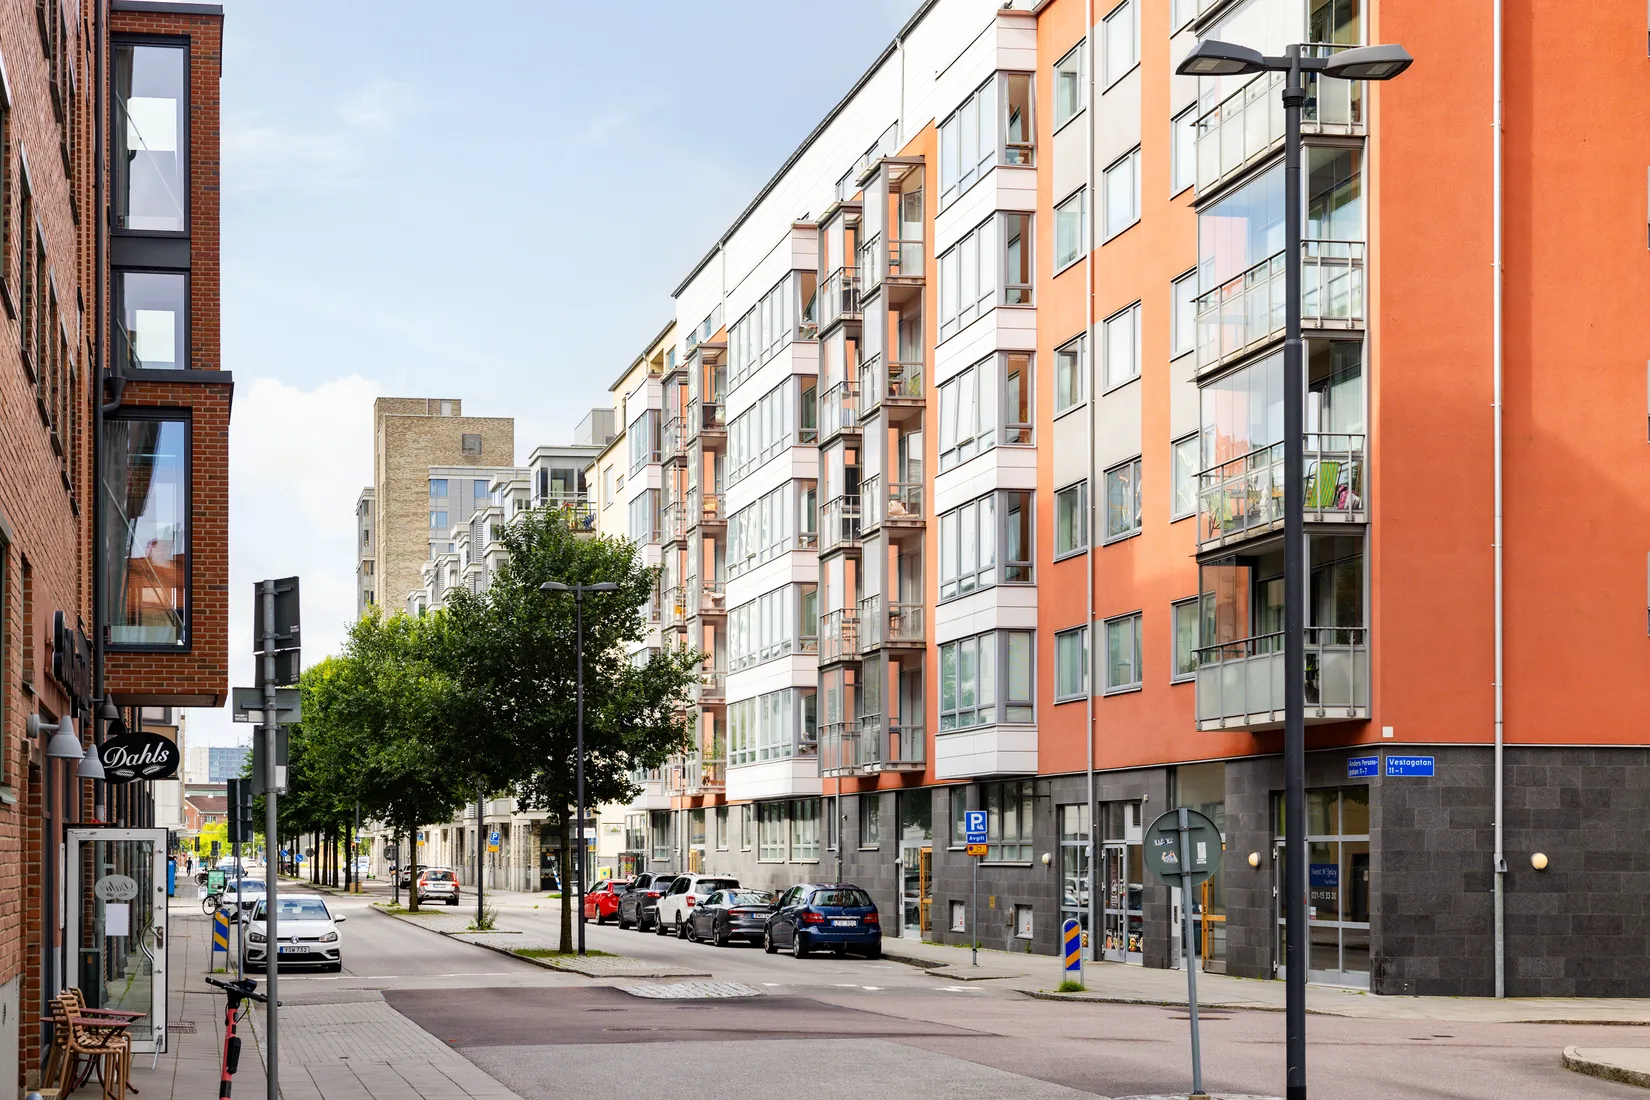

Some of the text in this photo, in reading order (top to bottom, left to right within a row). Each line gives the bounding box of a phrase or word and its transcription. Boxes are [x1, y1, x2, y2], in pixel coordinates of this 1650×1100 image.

[103, 741, 170, 769] Dahls
[1389, 758, 1432, 767] Vestagatan
[970, 813, 983, 831] P
